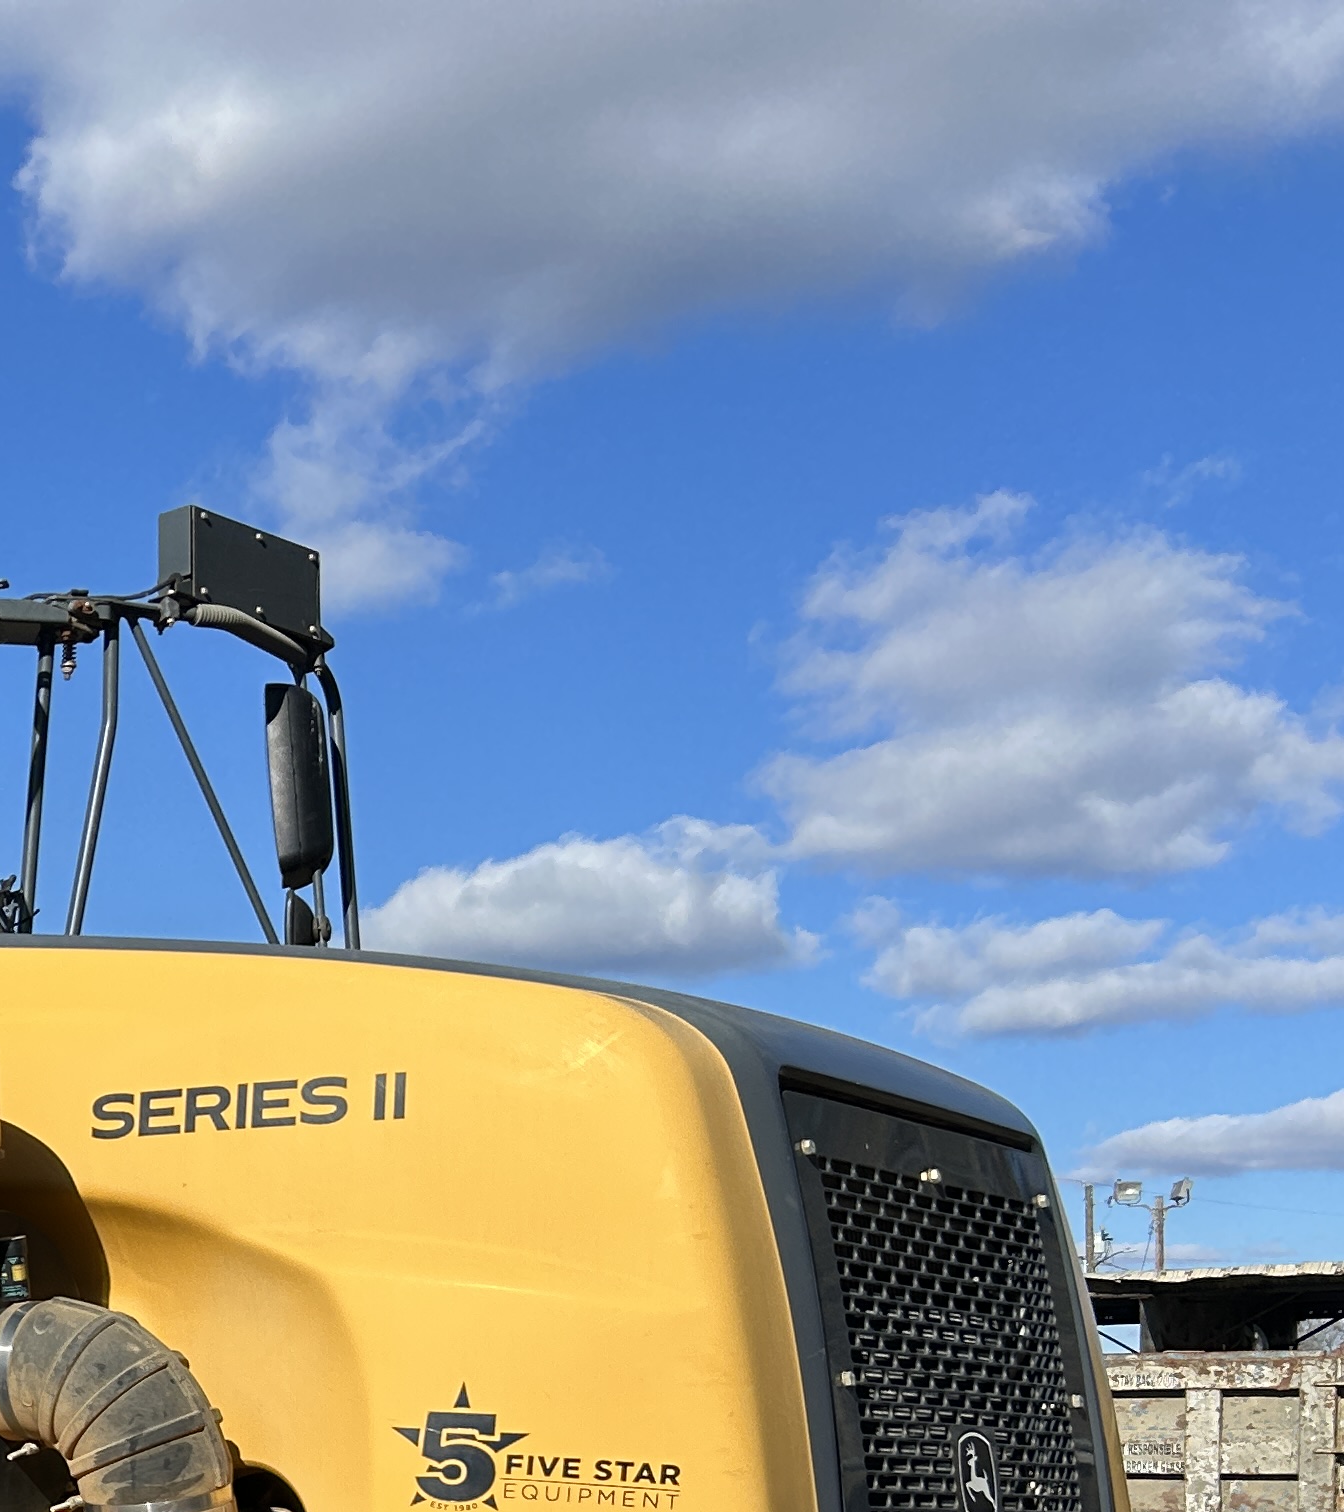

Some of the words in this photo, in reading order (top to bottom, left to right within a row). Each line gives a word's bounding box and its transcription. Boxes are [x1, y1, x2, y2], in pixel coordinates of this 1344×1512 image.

[91, 1076, 348, 1140] SERIES
[373, 1072, 407, 1120] II
[505, 1454, 582, 1479] FIVE
[593, 1459, 681, 1486] STAR
[430, 1501, 449, 1511] EST
[503, 1483, 681, 1510] EQUIPMENT
